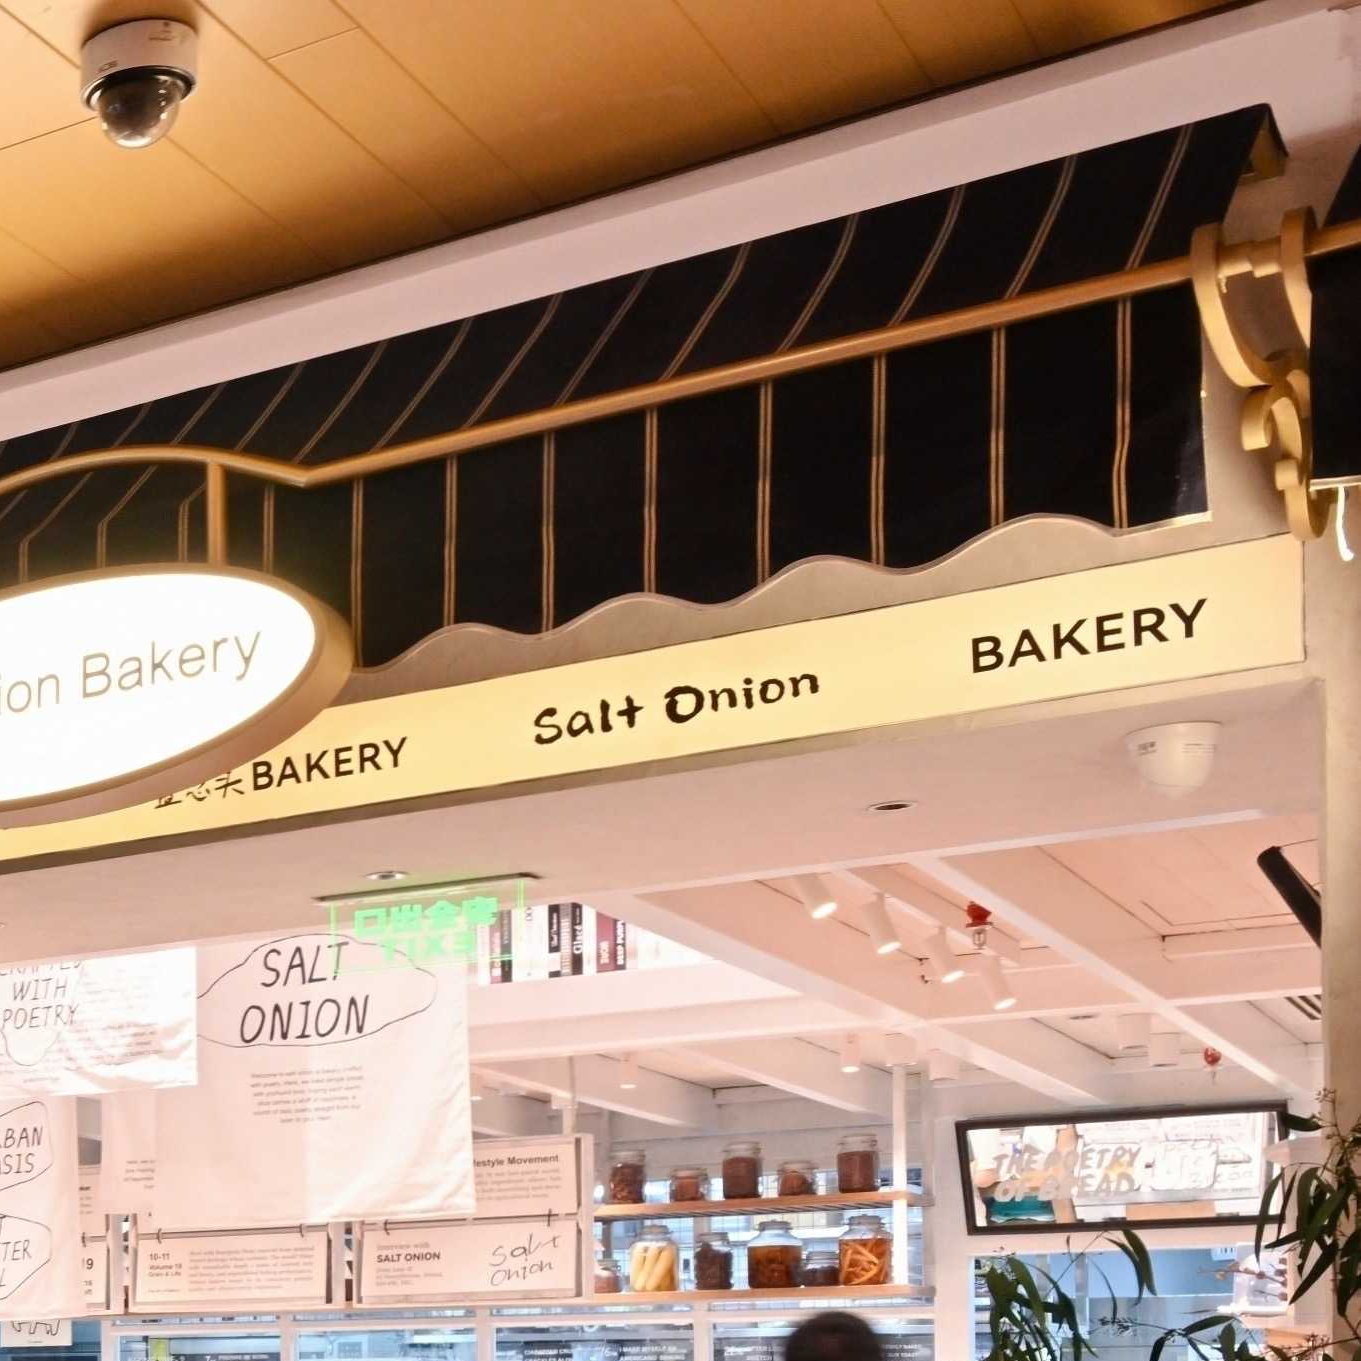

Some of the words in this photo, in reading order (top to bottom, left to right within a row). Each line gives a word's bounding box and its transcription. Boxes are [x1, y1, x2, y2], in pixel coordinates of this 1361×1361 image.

[969, 598, 1209, 675] BAKERY
[79, 631, 262, 699] Bakery
[533, 696, 645, 746] Salt
[663, 670, 820, 725] Onion
[251, 737, 408, 791] BAKERY
[261, 940, 346, 988] SALT
[13, 978, 68, 1001] WITH
[2, 1004, 79, 1031] POETRY
[240, 995, 369, 1046] ONION
[507, 1154, 559, 1166] Movement
[993, 1145, 1040, 1174] THE
[149, 1252, 170, 1261] 10-11
[376, 1254, 402, 1264] SALT
[404, 1252, 441, 1262] ONION
